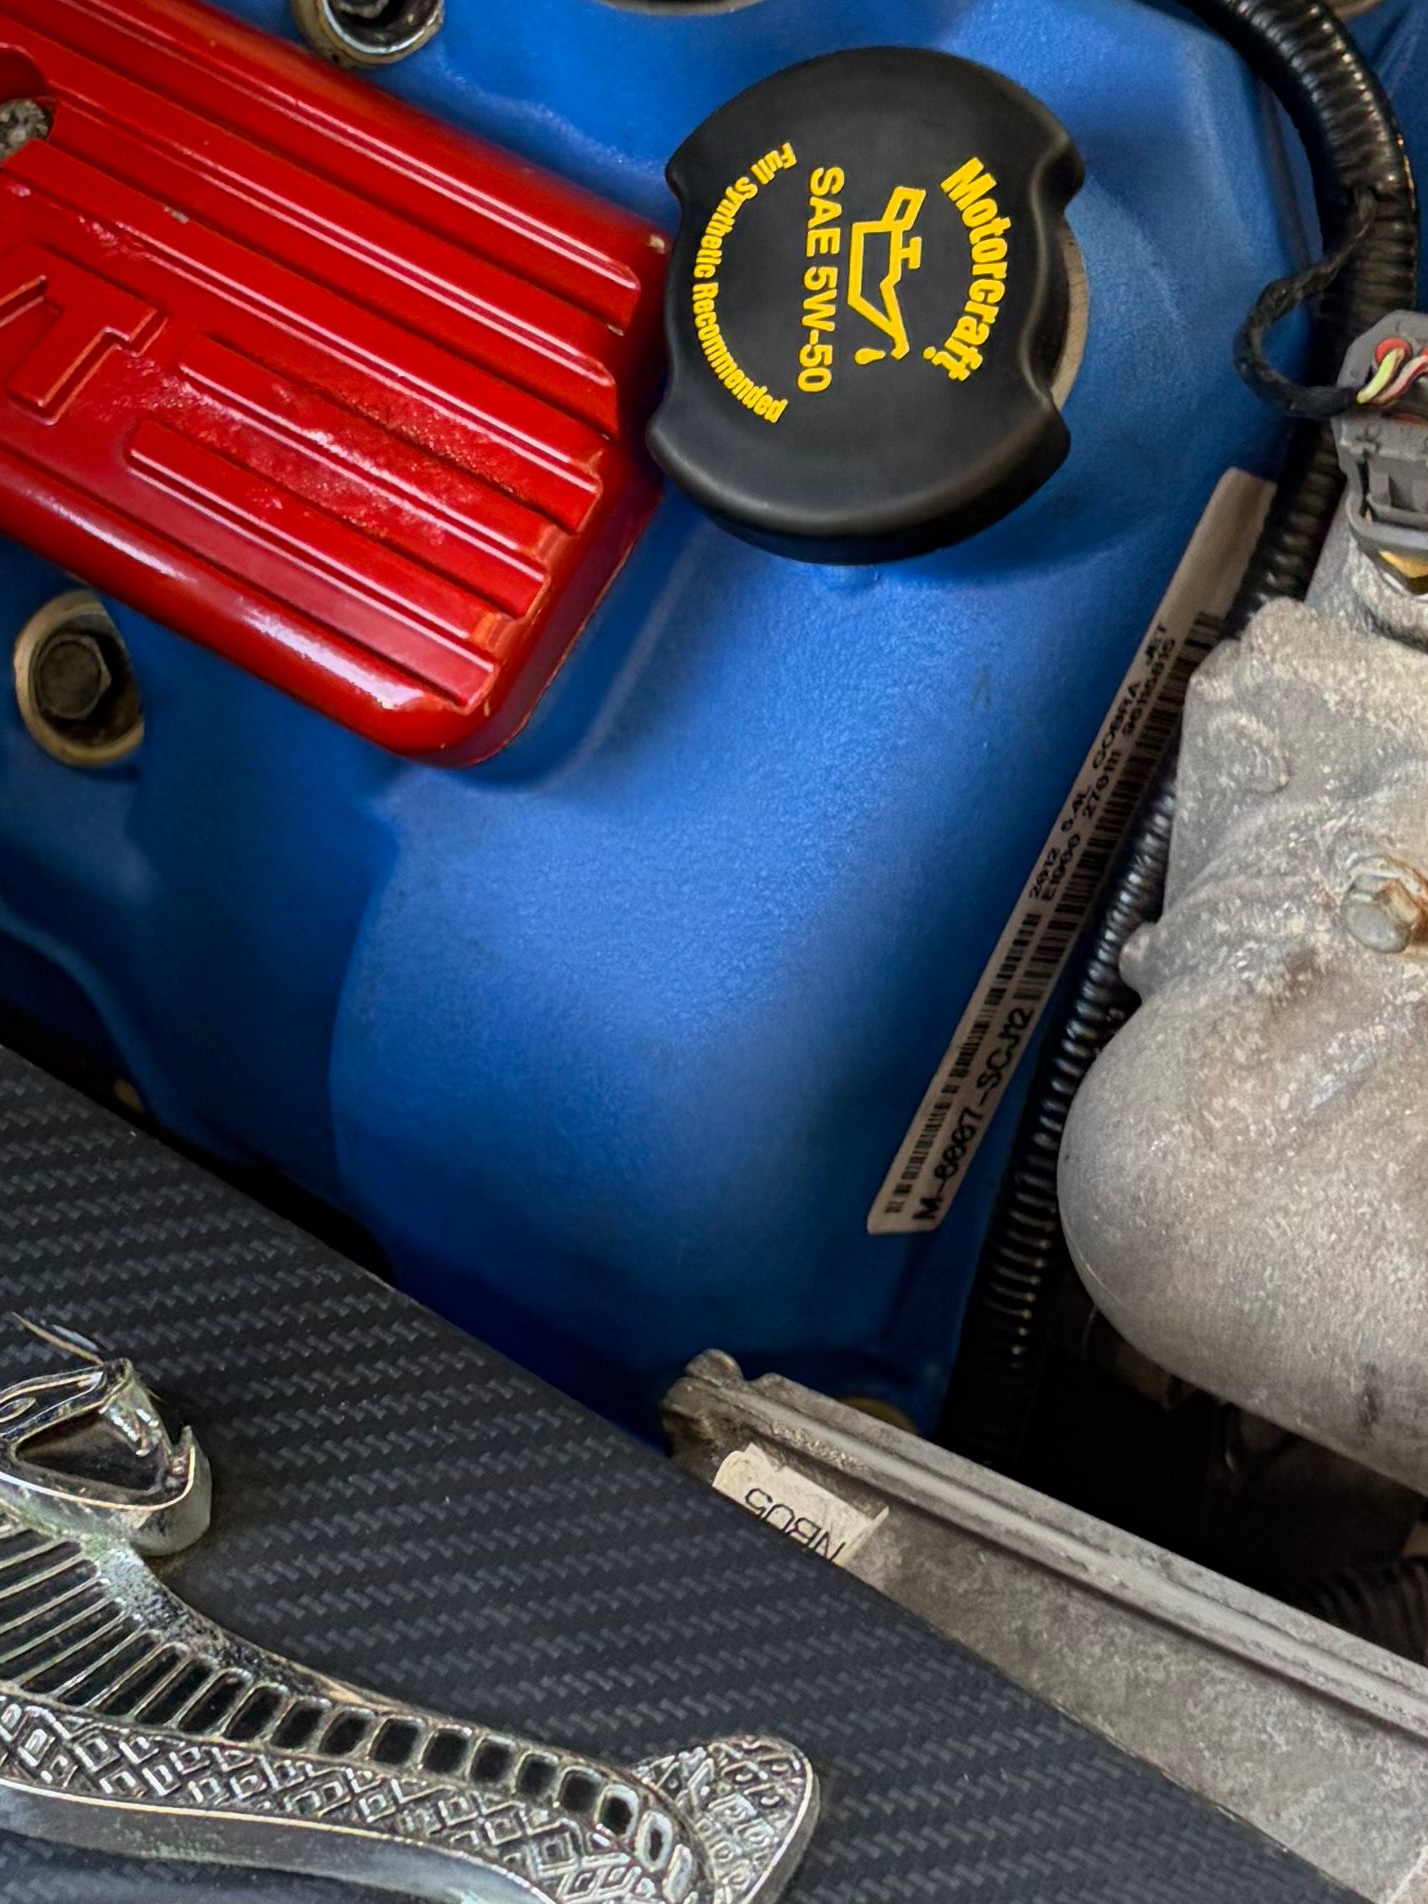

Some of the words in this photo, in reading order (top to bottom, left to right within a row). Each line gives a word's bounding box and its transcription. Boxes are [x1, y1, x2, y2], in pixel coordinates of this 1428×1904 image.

[693, 176, 759, 279] Synthetic
[749, 142, 798, 185] Full
[805, 166, 846, 317] SAE
[691, 281, 790, 424] Recommended
[797, 265, 839, 393] 5W-50
[1091, 680, 1142, 771] COBRA
[1144, 621, 1168, 667] JET
